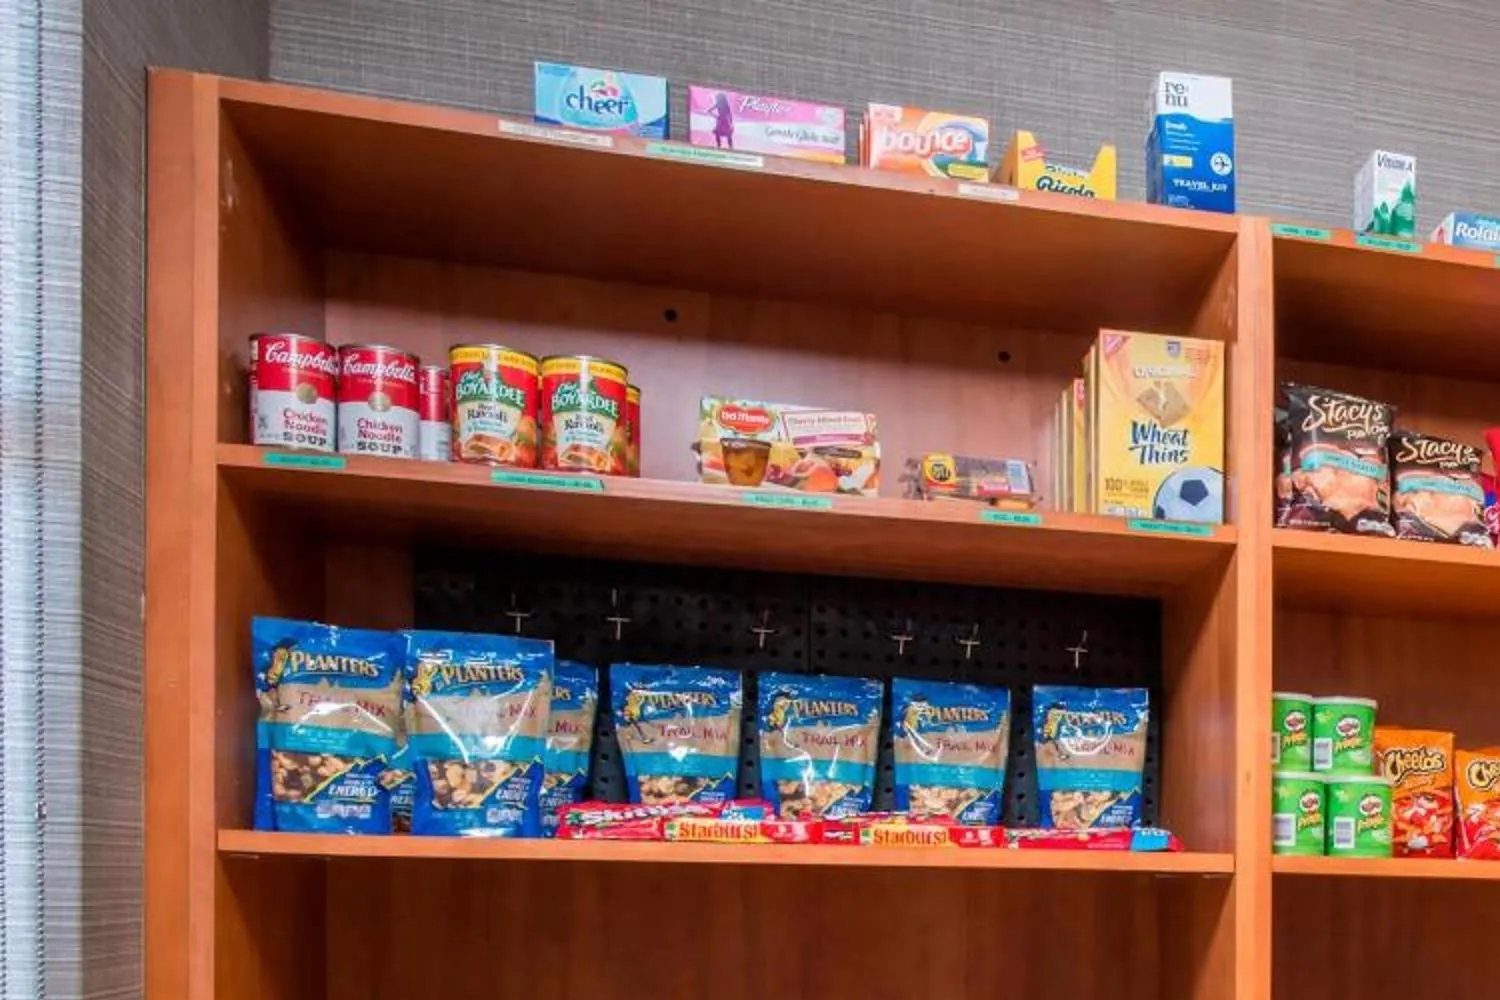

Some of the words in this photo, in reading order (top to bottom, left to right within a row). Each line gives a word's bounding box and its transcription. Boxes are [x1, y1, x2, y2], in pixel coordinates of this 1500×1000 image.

[564, 84, 630, 116] cheer
[882, 126, 971, 156] bounce
[1035, 175, 1096, 198] Ricola
[356, 417, 404, 434] Chicken
[1130, 418, 1190, 447] Wheat
[282, 431, 328, 447] SOUP
[356, 429, 403, 443] Noodle
[355, 440, 403, 455] SOUP
[1128, 445, 1190, 466] Thins
[289, 651, 380, 678] PLANTERS
[439, 663, 524, 683] PLANTERS
[792, 698, 860, 716] PLANTERS
[1383, 747, 1446, 785] Cheetos
[678, 822, 759, 839] Starburst
[872, 828, 948, 846] Starburst
